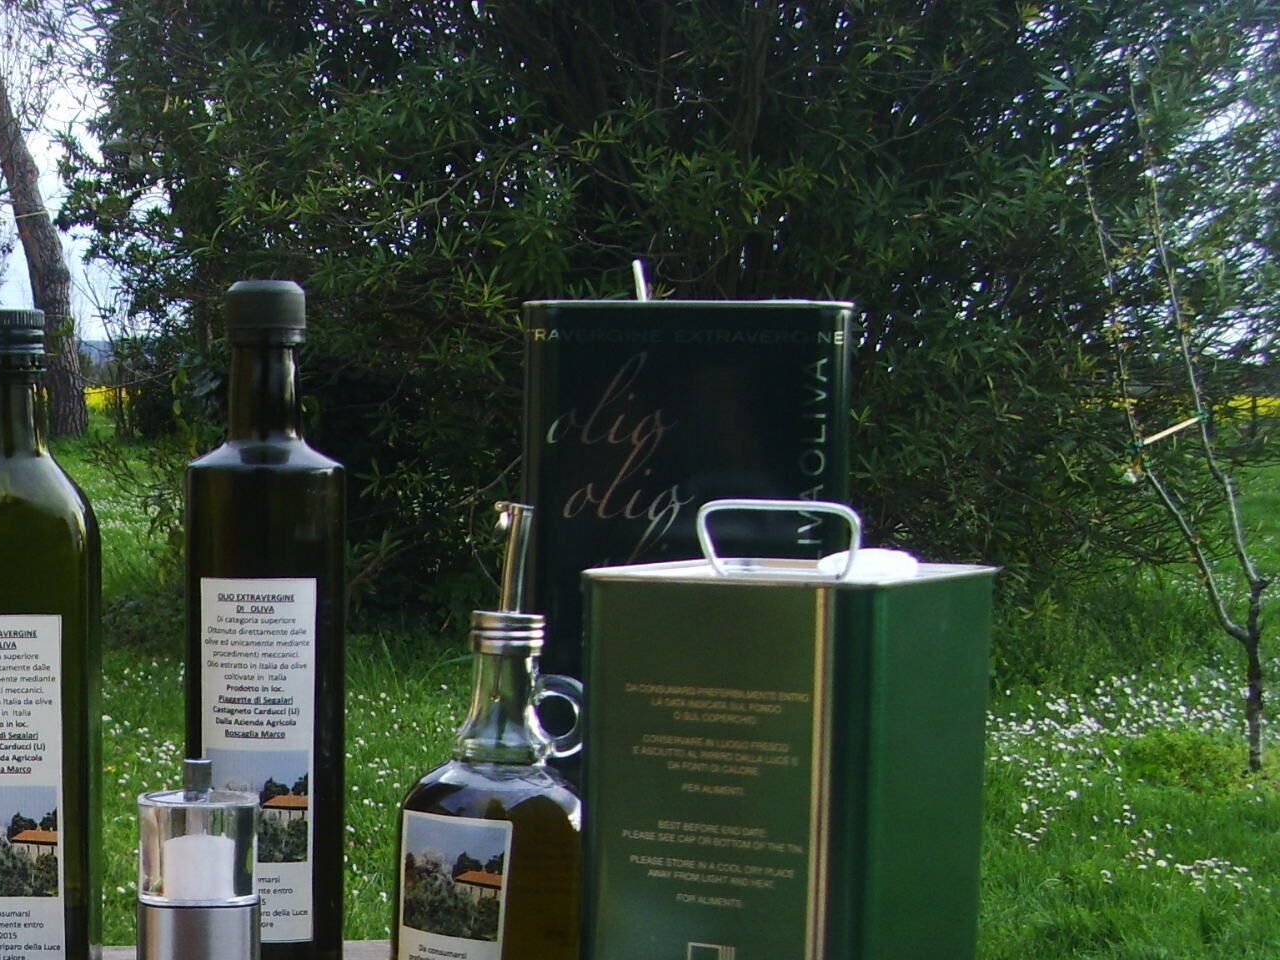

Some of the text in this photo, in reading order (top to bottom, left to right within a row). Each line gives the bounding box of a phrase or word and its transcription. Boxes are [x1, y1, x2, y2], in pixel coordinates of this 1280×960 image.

[217, 593, 295, 603] OLIO EXTRAVERGINE
[236, 605, 275, 614] DI OLIVA
[225, 617, 259, 625] categoria
[261, 617, 297, 625] superiore
[3, 653, 39, 662] superiore
[259, 662, 278, 670] Italia
[224, 673, 255, 681] coltivate
[226, 684, 259, 692] Prodotto
[254, 696, 261, 705] di
[1, 709, 9, 717] in
[12, 709, 31, 717] Italia
[212, 706, 252, 715] Castagneto
[253, 707, 286, 715] Carducci
[234, 718, 264, 726] Azienda
[265, 719, 297, 727] Agricola
[0, 732, 6, 741] di
[261, 730, 286, 739] Marco
[11, 754, 43, 763] Agricola
[6, 766, 32, 774] Marco
[0, 943, 23, 952] riparo
[44, 943, 62, 951] Luce
[2, 953, 26, 960] calore
